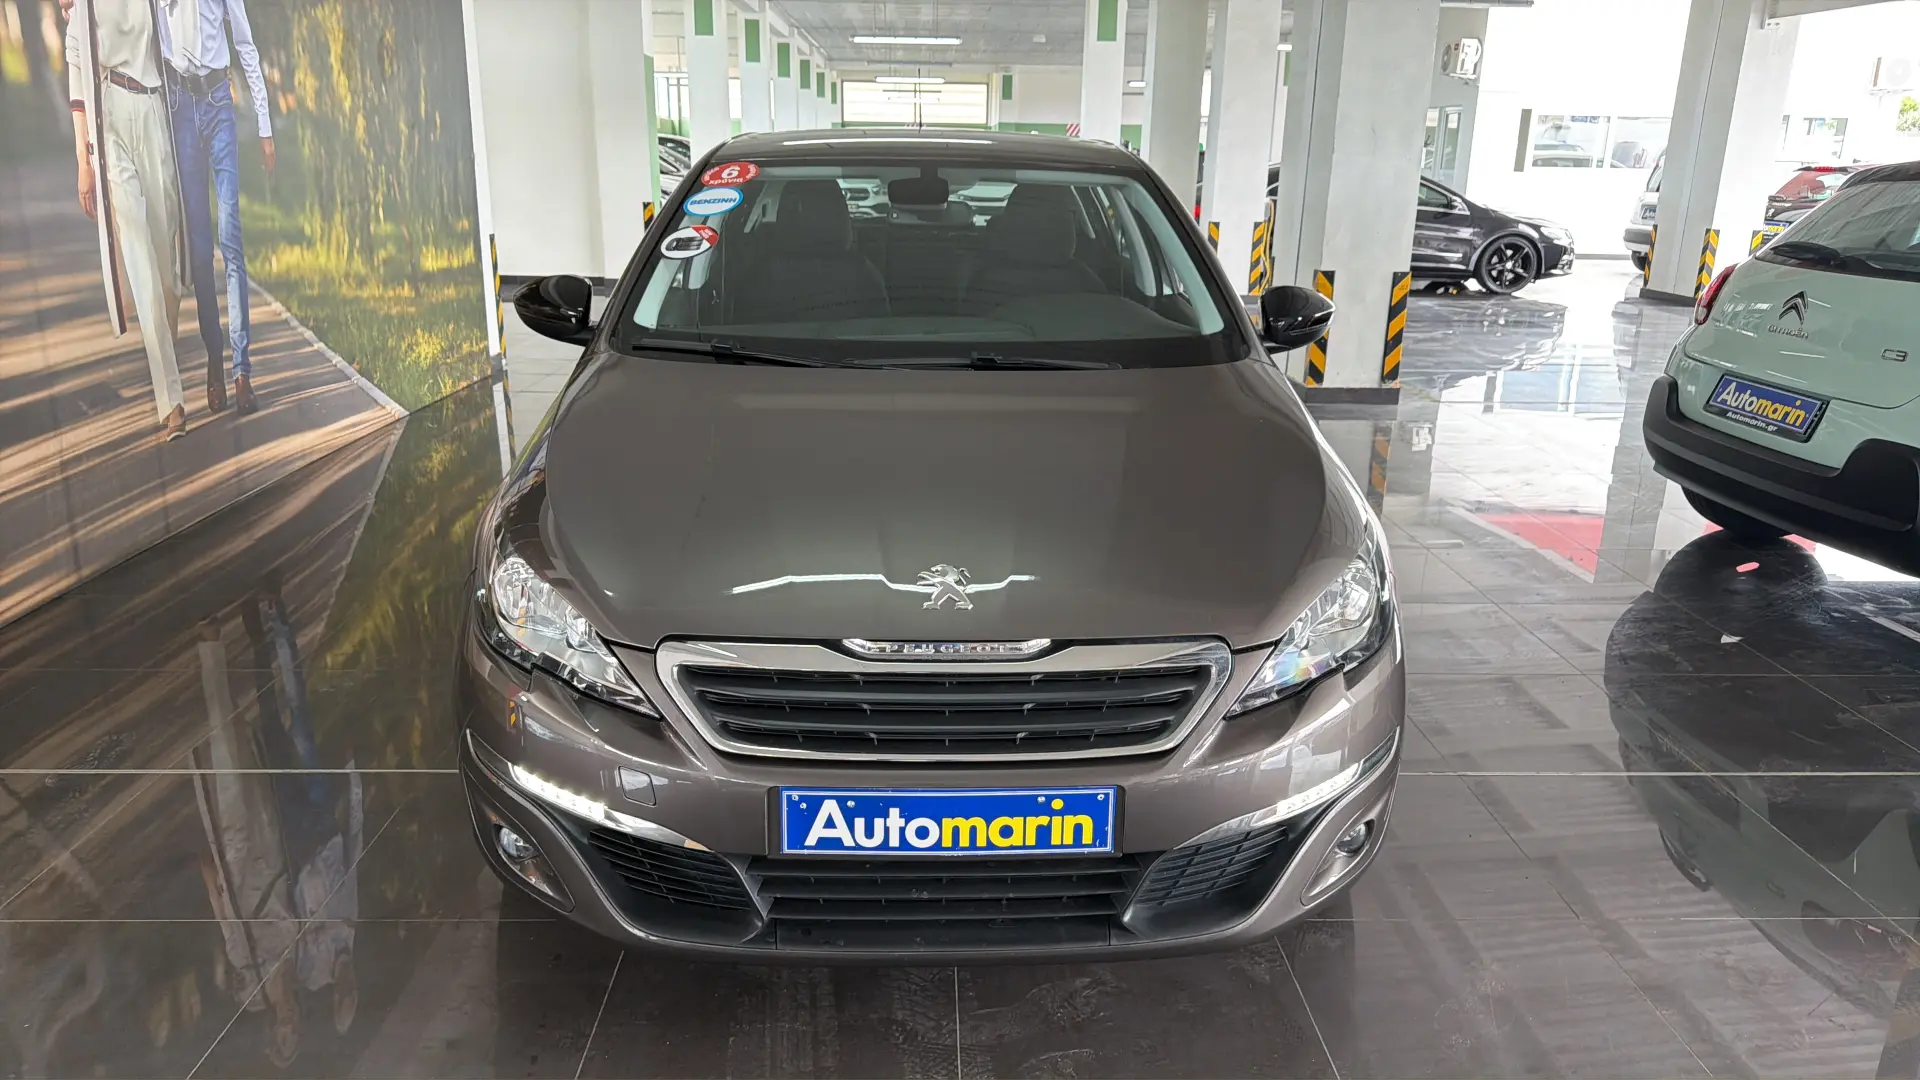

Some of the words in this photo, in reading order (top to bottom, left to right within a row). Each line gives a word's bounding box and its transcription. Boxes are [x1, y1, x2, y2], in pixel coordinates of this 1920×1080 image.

[721, 165, 741, 179] 6
[1881, 348, 1909, 362] C3
[1716, 381, 1807, 427] Automarin
[1726, 411, 1779, 432] Automarin.gr
[885, 642, 1008, 654] PEUGEOT
[803, 798, 1093, 848] Automarin
